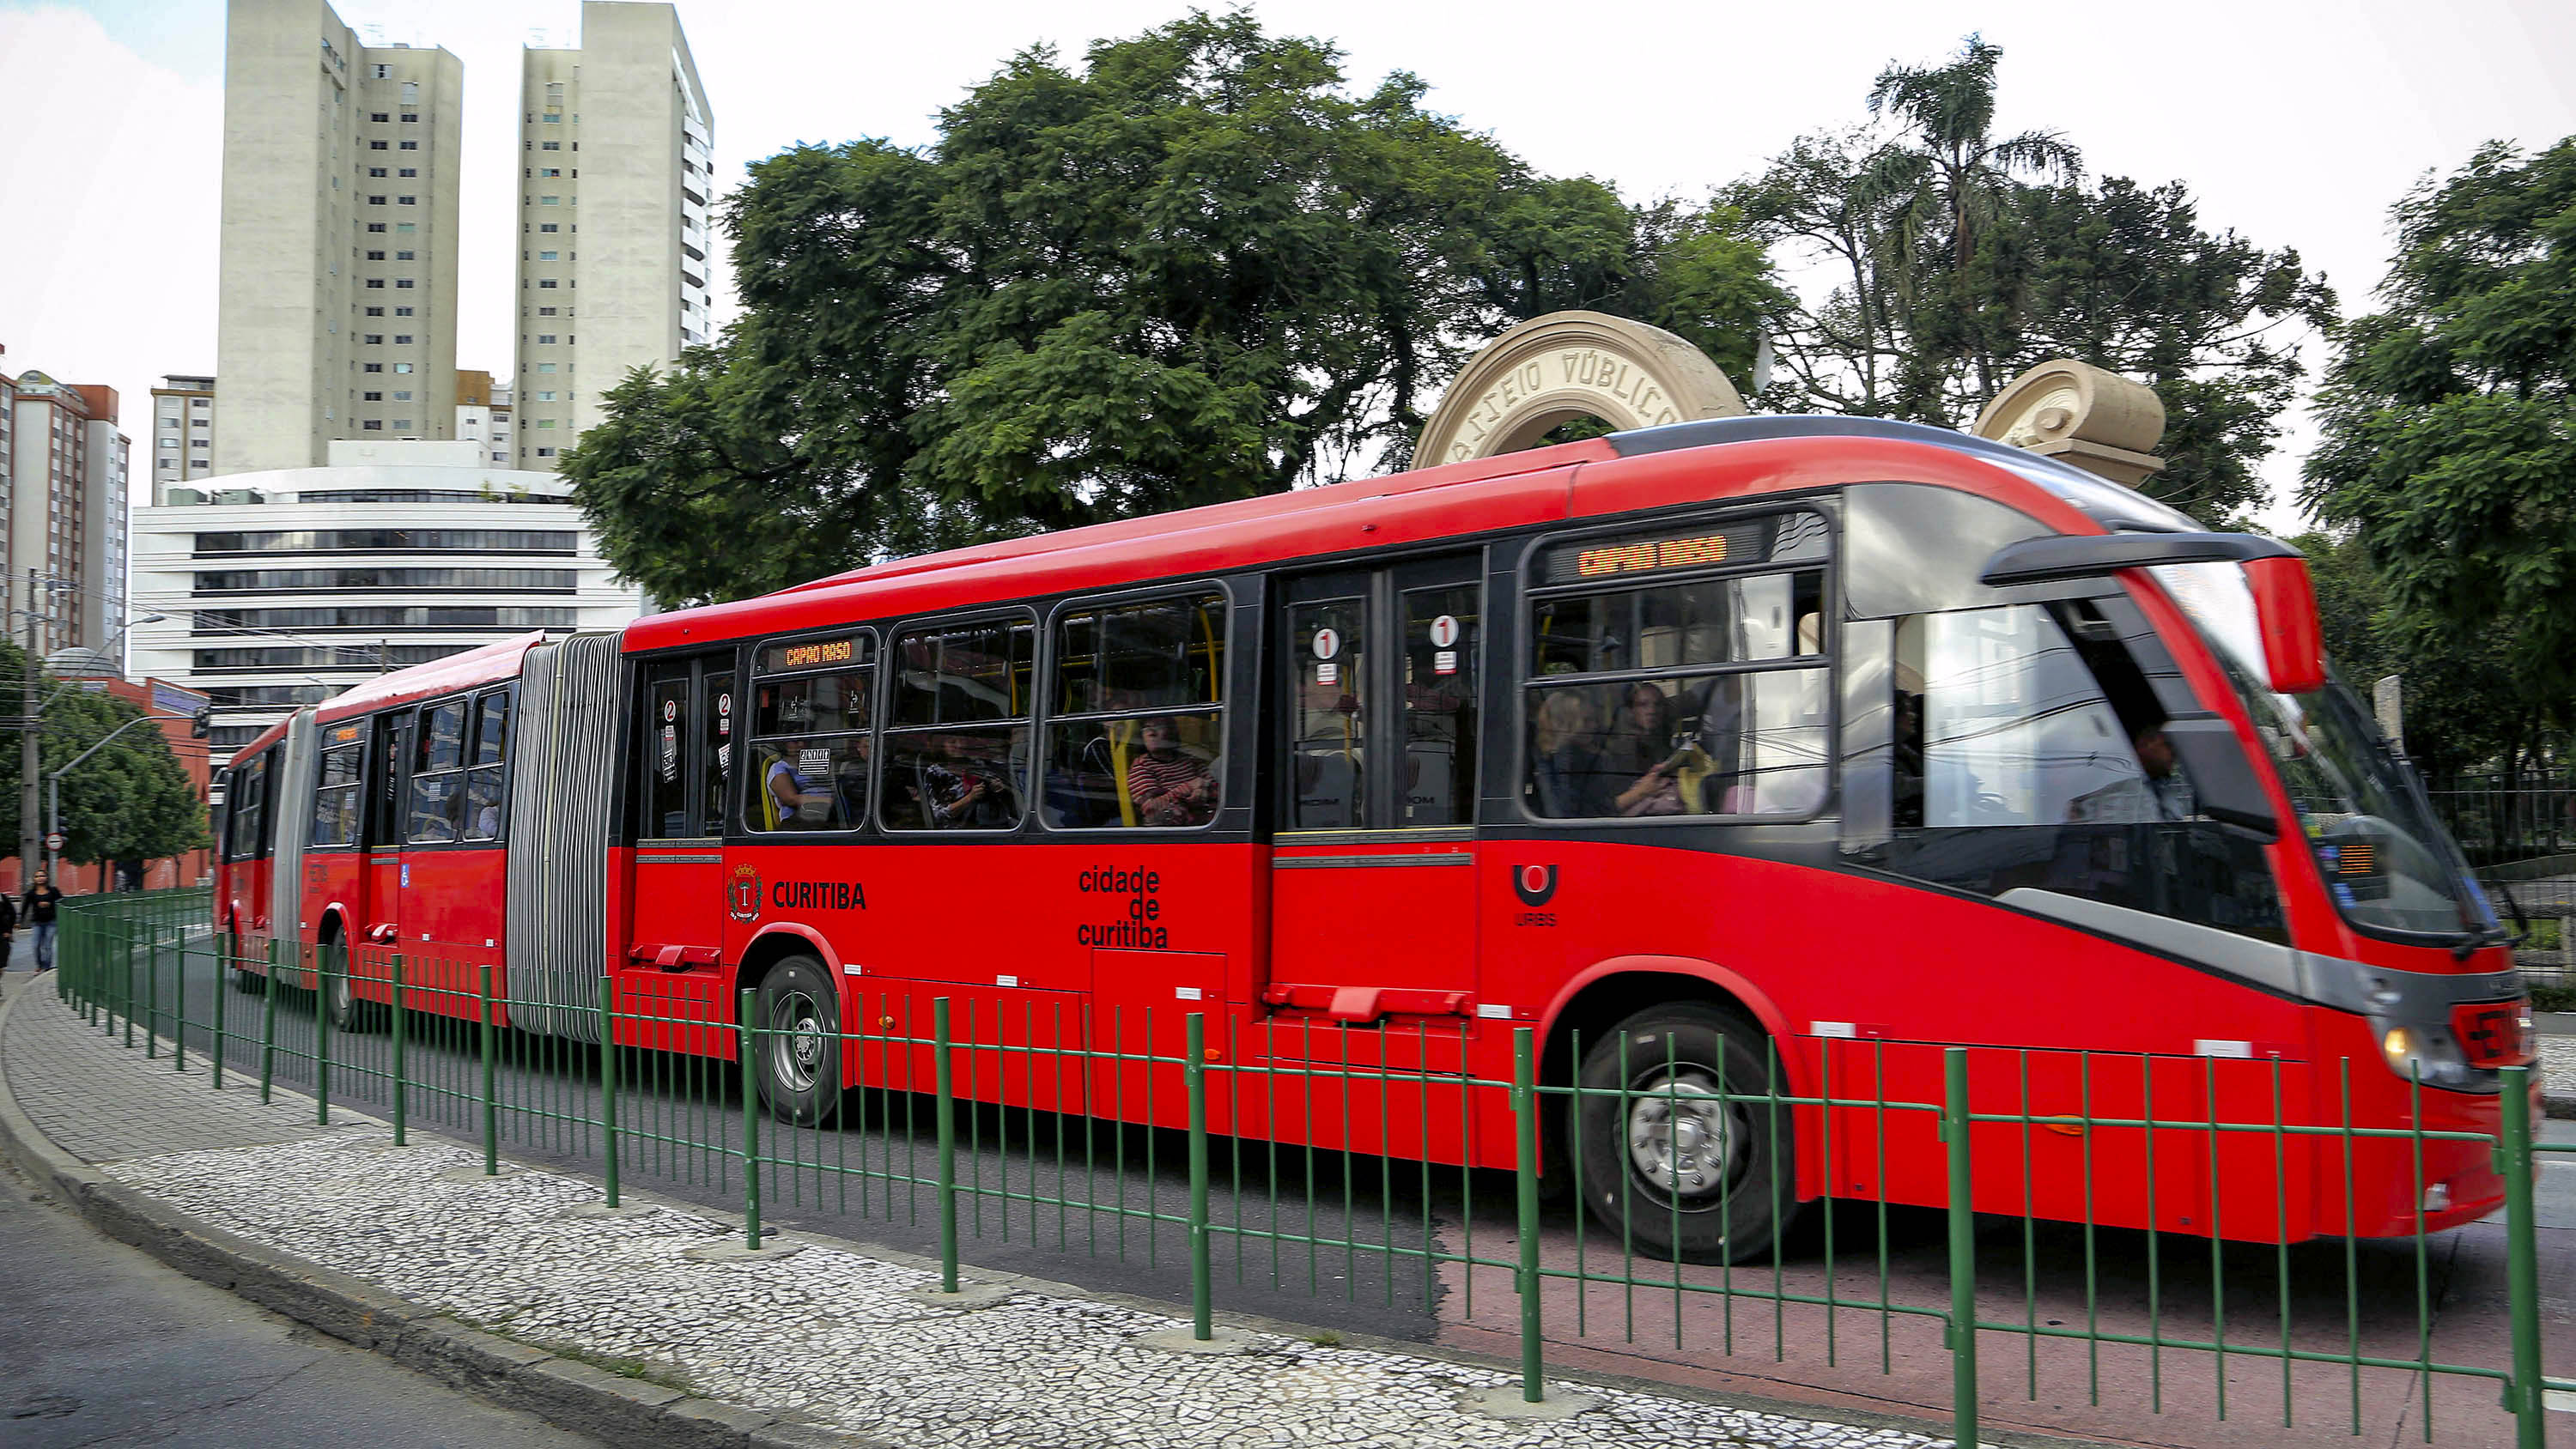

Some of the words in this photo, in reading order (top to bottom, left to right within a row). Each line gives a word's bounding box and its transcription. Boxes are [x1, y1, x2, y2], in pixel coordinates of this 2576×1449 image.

[1450, 361, 1542, 462] ASSEIO
[1319, 631, 1330, 657] 1
[1437, 617, 1449, 644] 1
[785, 645, 820, 667] CAPAO
[822, 640, 852, 662] RASO
[666, 701, 674, 719] 2
[721, 694, 729, 713] 2
[1079, 864, 1160, 894] cidade
[773, 881, 866, 910] CURITIBA
[1130, 897, 1160, 921] de
[1078, 919, 1169, 949] curitiba
